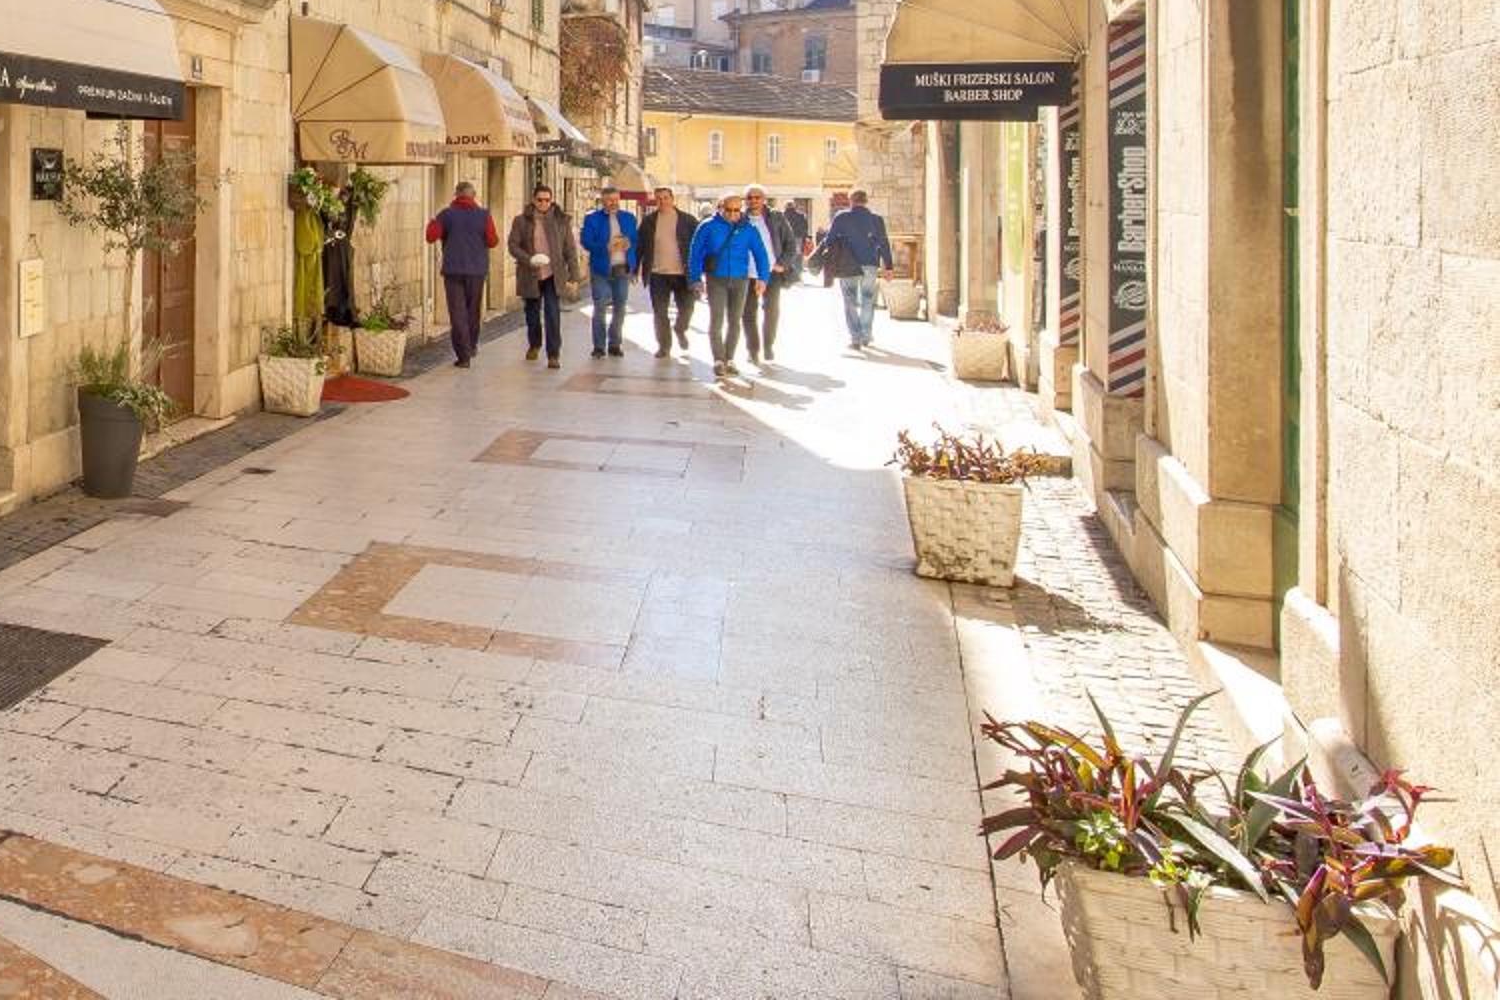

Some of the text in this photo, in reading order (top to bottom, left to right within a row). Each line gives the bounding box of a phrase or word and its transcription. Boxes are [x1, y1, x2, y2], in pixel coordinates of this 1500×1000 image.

[915, 71, 1056, 87] MUŠKI FRIZERSKI SALON
[943, 89, 1024, 103] BARBER SHOP
